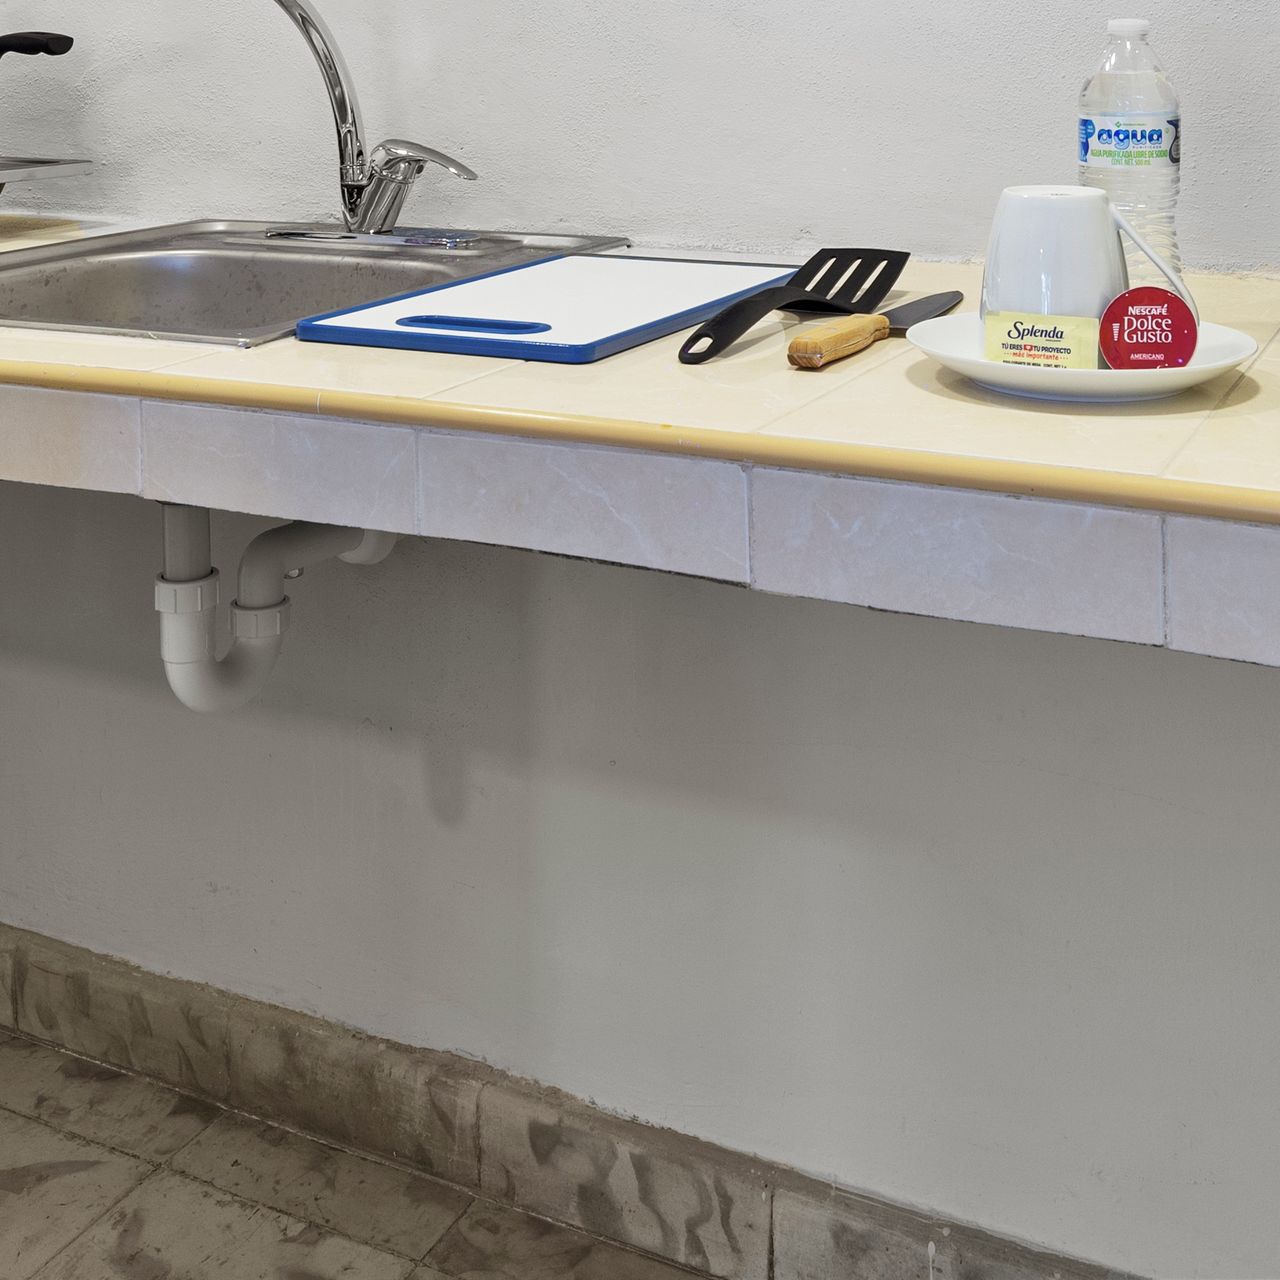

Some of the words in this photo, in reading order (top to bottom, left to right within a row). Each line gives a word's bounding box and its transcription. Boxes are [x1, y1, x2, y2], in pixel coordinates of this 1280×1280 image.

[1097, 128, 1163, 150] agua
[1102, 149, 1132, 158] PURIFICADA
[1128, 304, 1168, 316] NESCAFÉ
[1123, 315, 1172, 331] Dolce
[1007, 320, 1065, 341] Splenda
[1123, 329, 1172, 344] Gusto
[1009, 343, 1023, 351] ERES
[1033, 345, 1040, 353] TU
[1041, 346, 1072, 355] PROYECTO
[1025, 352, 1060, 360] importante
[1129, 353, 1165, 361] AMERICANO
